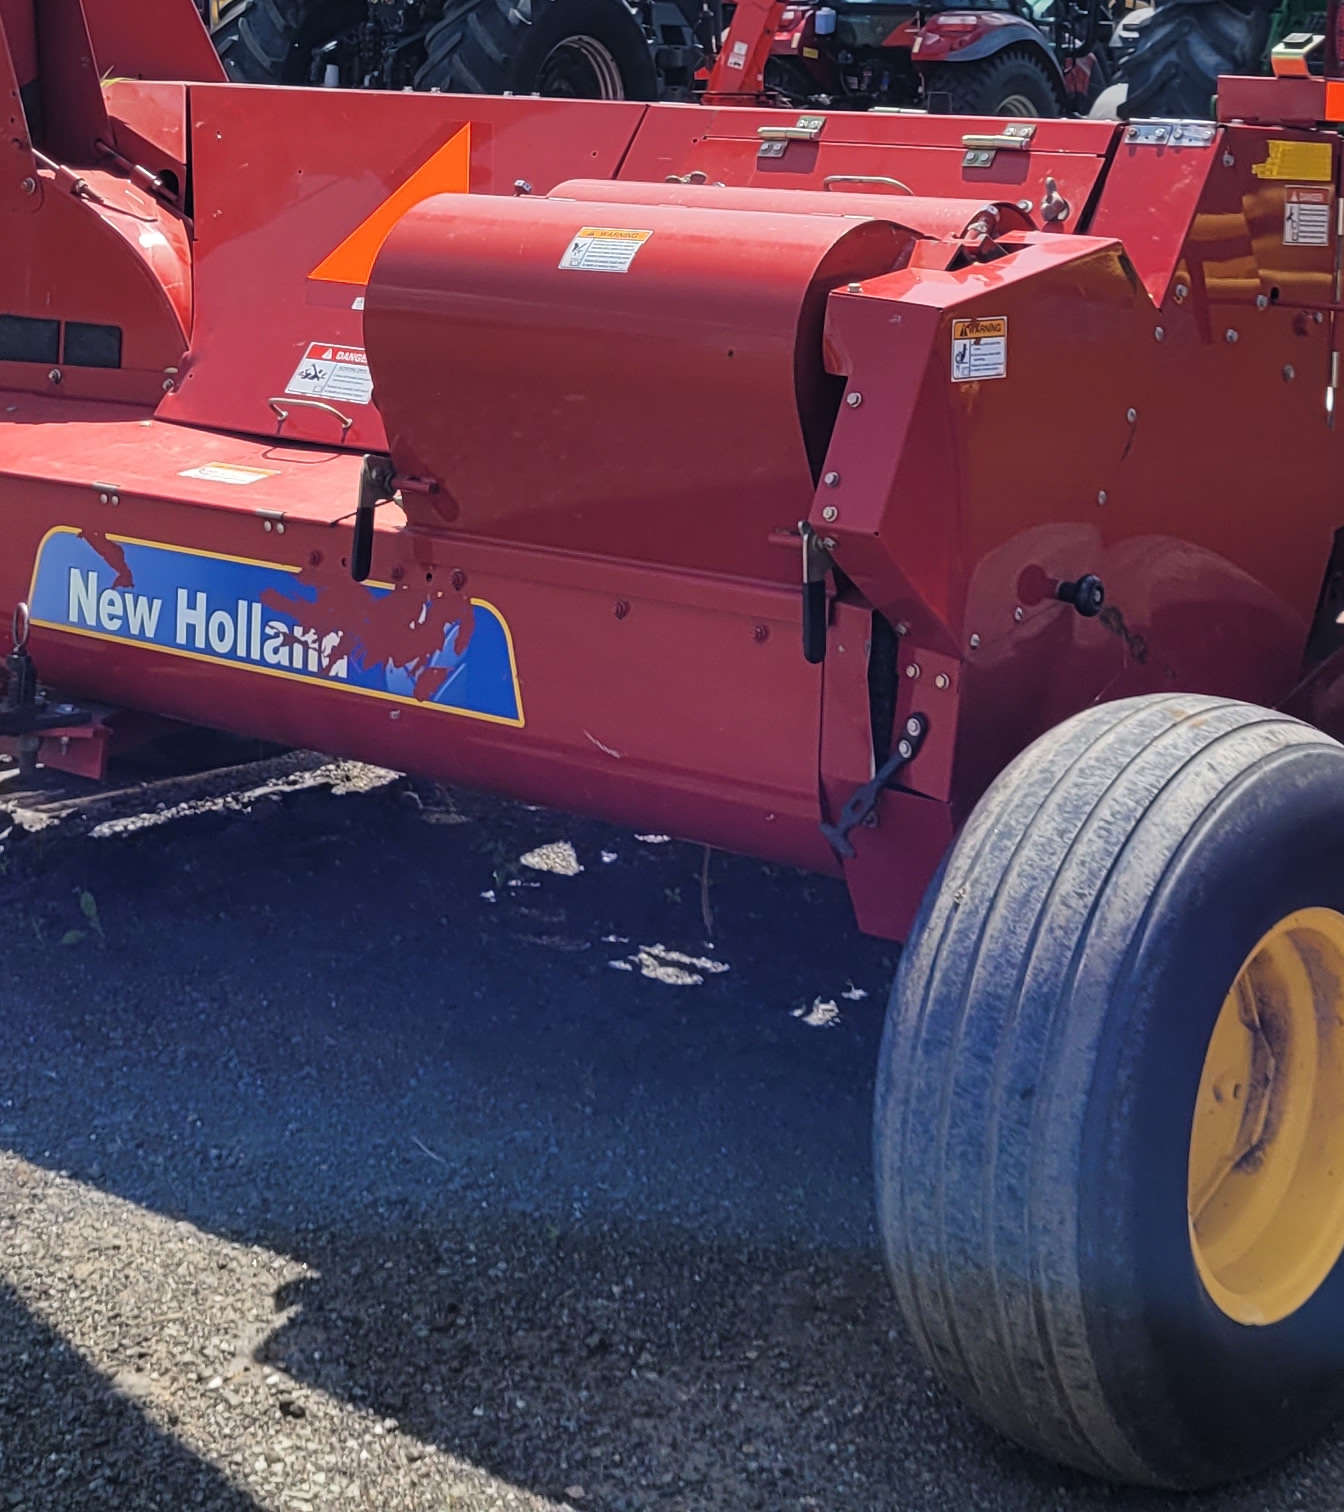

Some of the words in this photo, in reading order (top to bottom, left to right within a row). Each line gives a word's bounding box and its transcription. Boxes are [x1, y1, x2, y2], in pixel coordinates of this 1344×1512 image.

[599, 230, 640, 239] WARNING
[968, 322, 1003, 335] WARNING
[335, 350, 368, 364] DANGE
[68, 567, 162, 638] New
